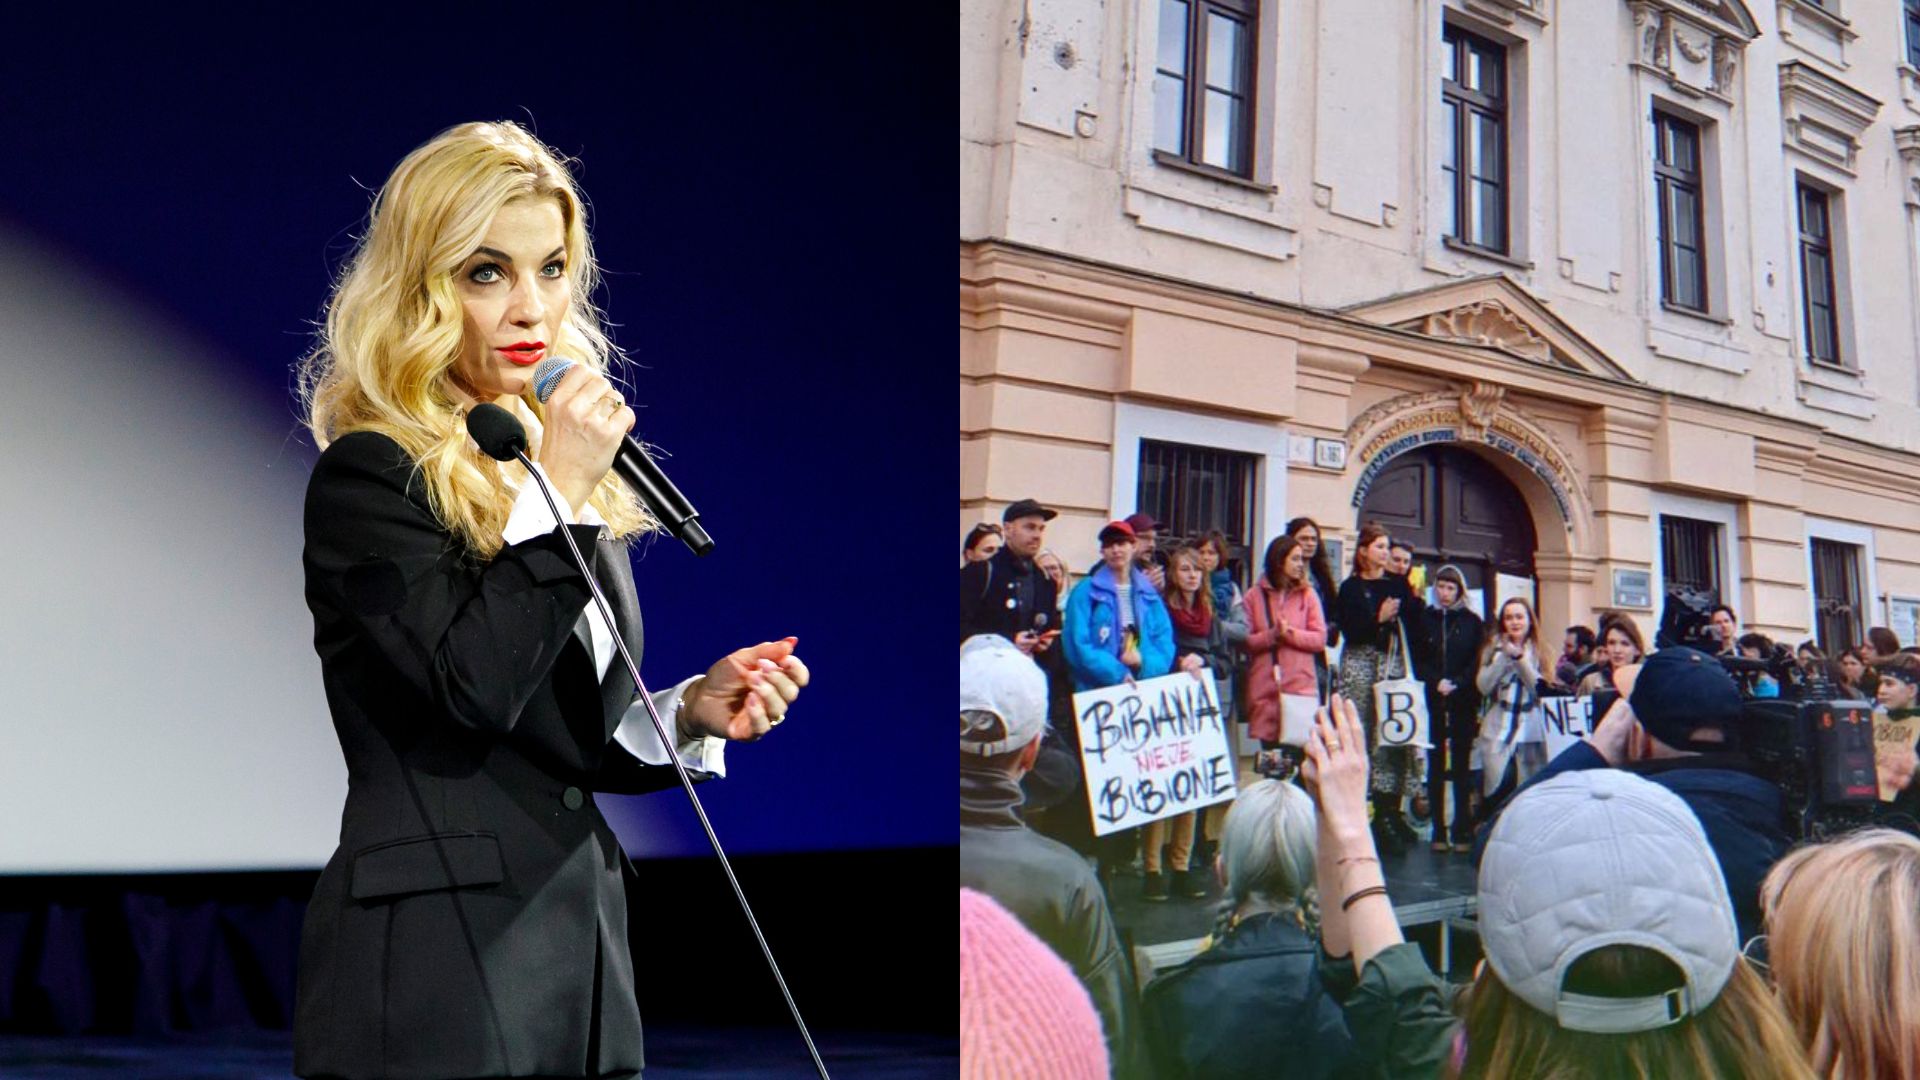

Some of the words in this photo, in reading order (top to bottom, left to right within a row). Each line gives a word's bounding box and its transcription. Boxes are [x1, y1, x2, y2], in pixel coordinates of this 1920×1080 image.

[1082, 677, 1221, 763] BIBIANA
[1381, 691, 1417, 745] B
[1098, 754, 1237, 824] BIBIONE
